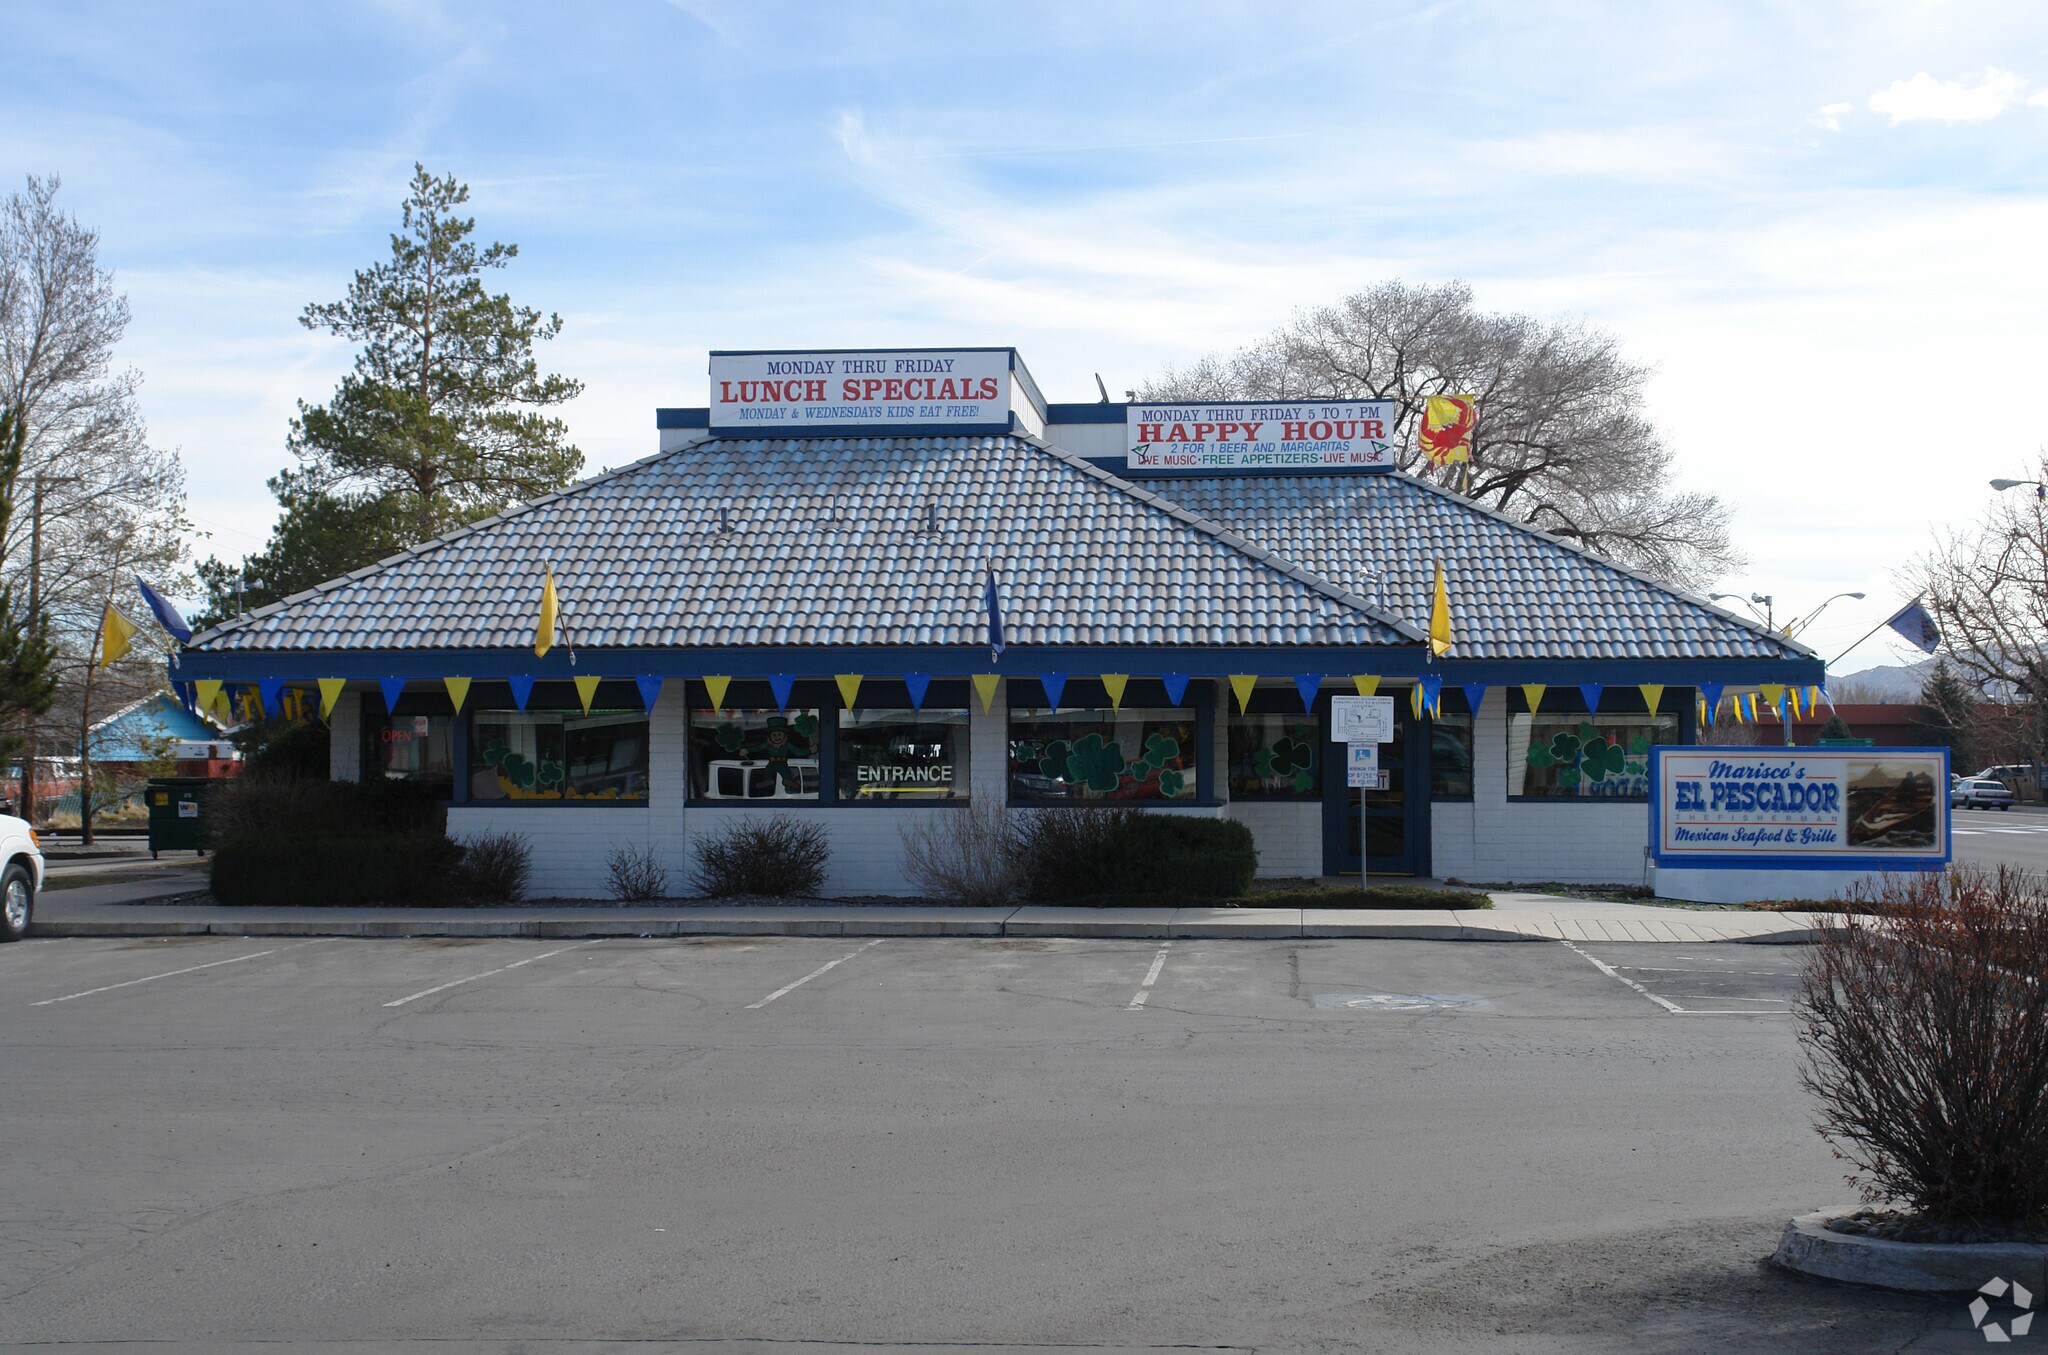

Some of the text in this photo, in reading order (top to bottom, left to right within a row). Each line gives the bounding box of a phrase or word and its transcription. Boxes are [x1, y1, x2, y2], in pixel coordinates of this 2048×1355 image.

[767, 359, 955, 375] MONDAY THRU FRIDAY
[720, 377, 998, 403] LUNCH SPECIALS
[739, 405, 980, 420] MONDAY & WEDNESDAYS KIDS EAT FREE!
[1142, 406, 1380, 422] MONDAY THRU FRIDAY 5 TO 7 PM
[1137, 420, 1387, 442] HAPPY HOUR
[1170, 440, 1350, 453] 2 FOR 1 BEER AND MARGARITAS
[1138, 452, 1384, 465] LIVE MUSIC FREE APPETIZERS LIVE MUSIC
[381, 728, 412, 743] OPEN
[857, 765, 952, 782] ENTRANCE
[1709, 760, 1806, 779] Marisco's
[1675, 781, 1706, 812] EL
[1710, 781, 1840, 813] PESCADOR
[1675, 826, 1837, 847] Mexican Seafood & Grille
